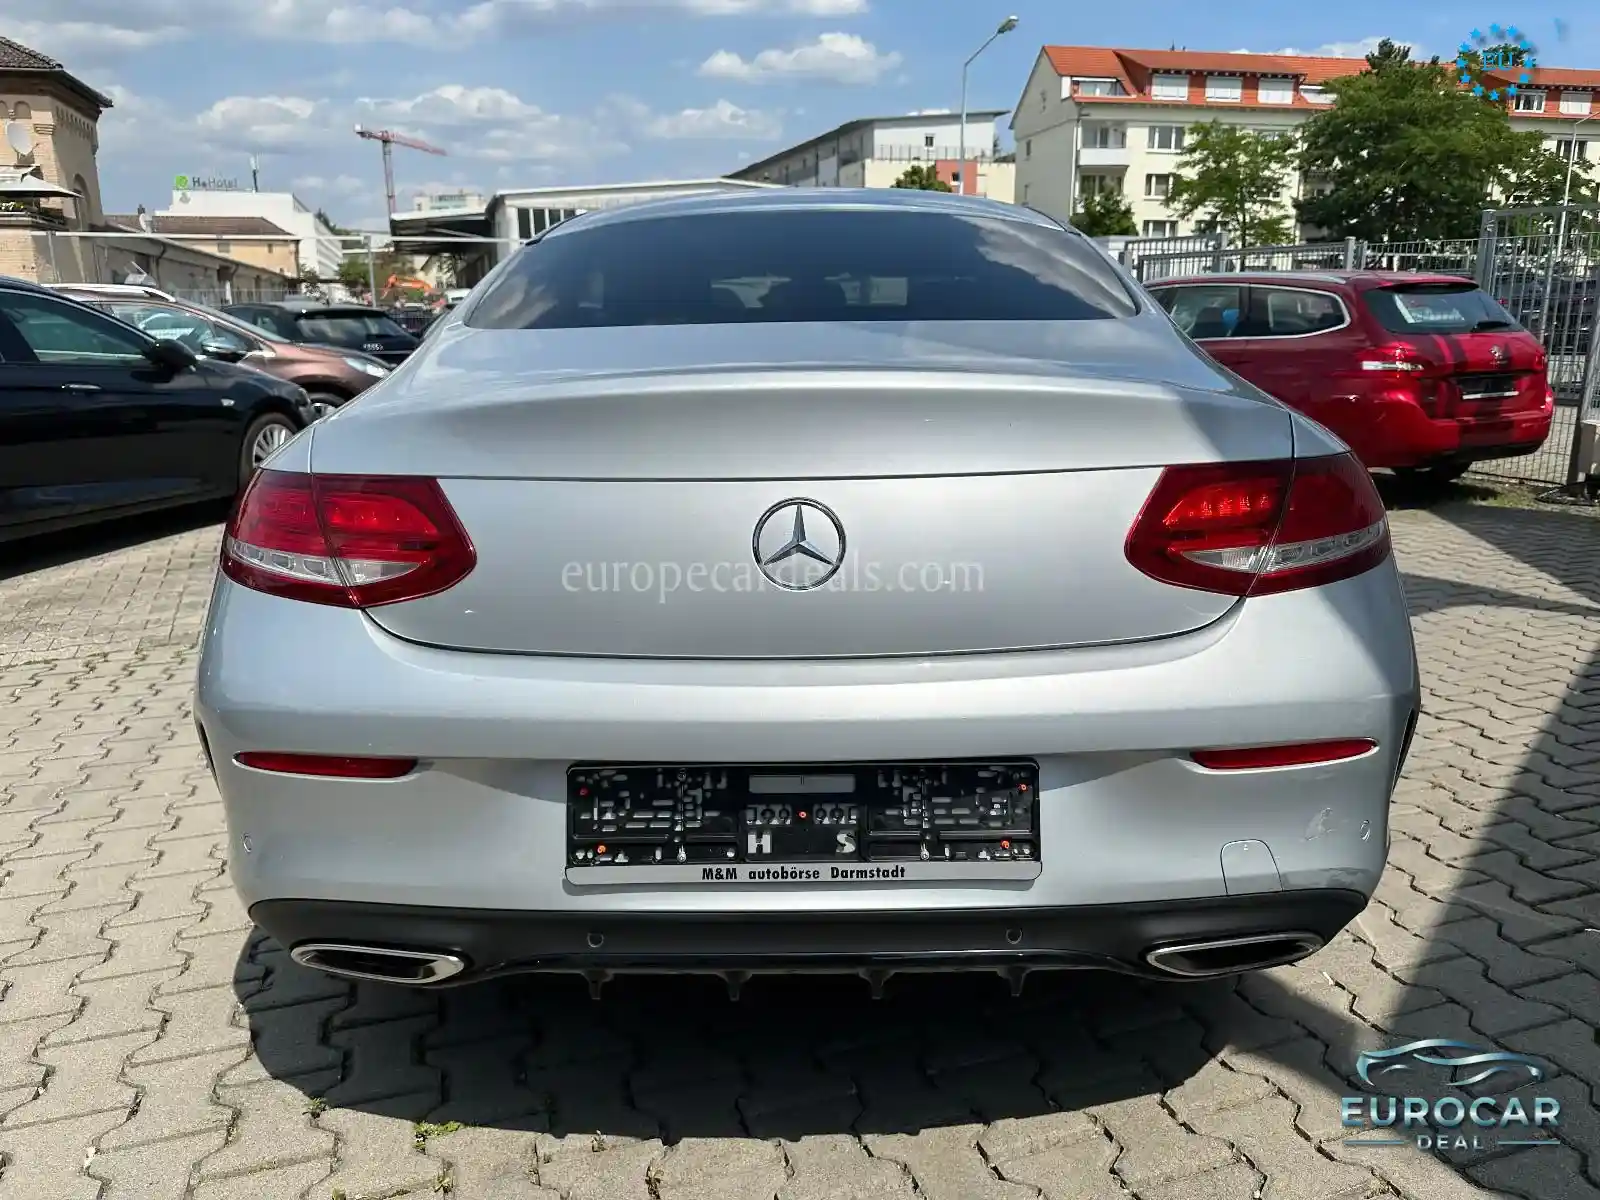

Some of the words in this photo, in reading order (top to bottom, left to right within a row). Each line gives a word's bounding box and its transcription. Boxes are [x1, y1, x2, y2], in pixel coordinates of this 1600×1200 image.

[747, 832, 772, 854] H
[835, 832, 857, 854] S
[702, 867, 738, 880] M&M
[748, 865, 820, 880] autobörse
[830, 865, 906, 879] Darmstadt
